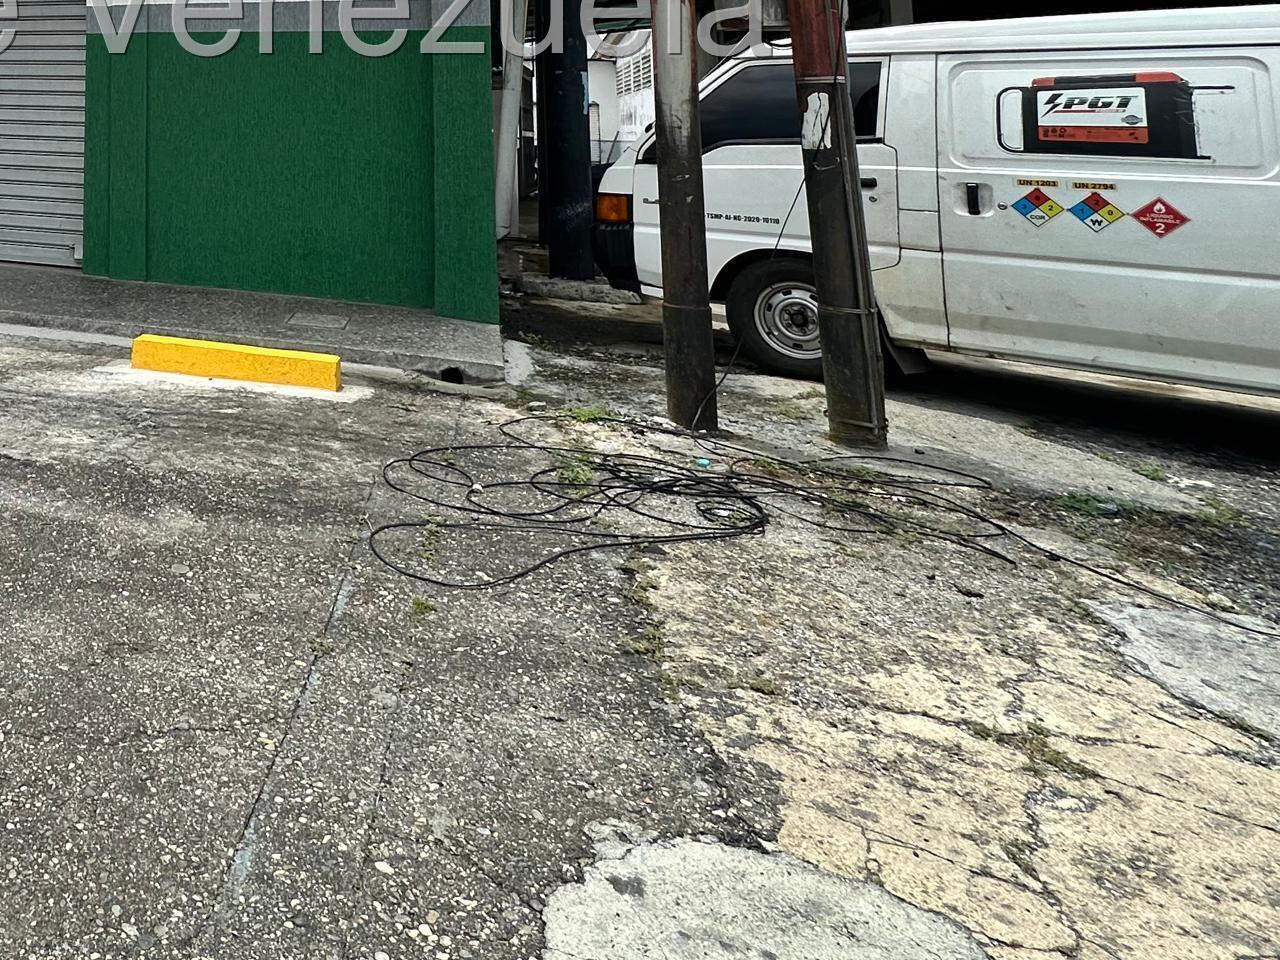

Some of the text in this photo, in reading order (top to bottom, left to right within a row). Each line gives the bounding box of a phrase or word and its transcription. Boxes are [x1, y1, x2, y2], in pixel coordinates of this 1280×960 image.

[1062, 95, 1139, 110] PGT
[1090, 218, 1104, 227] W
[1155, 223, 1166, 234] 2
